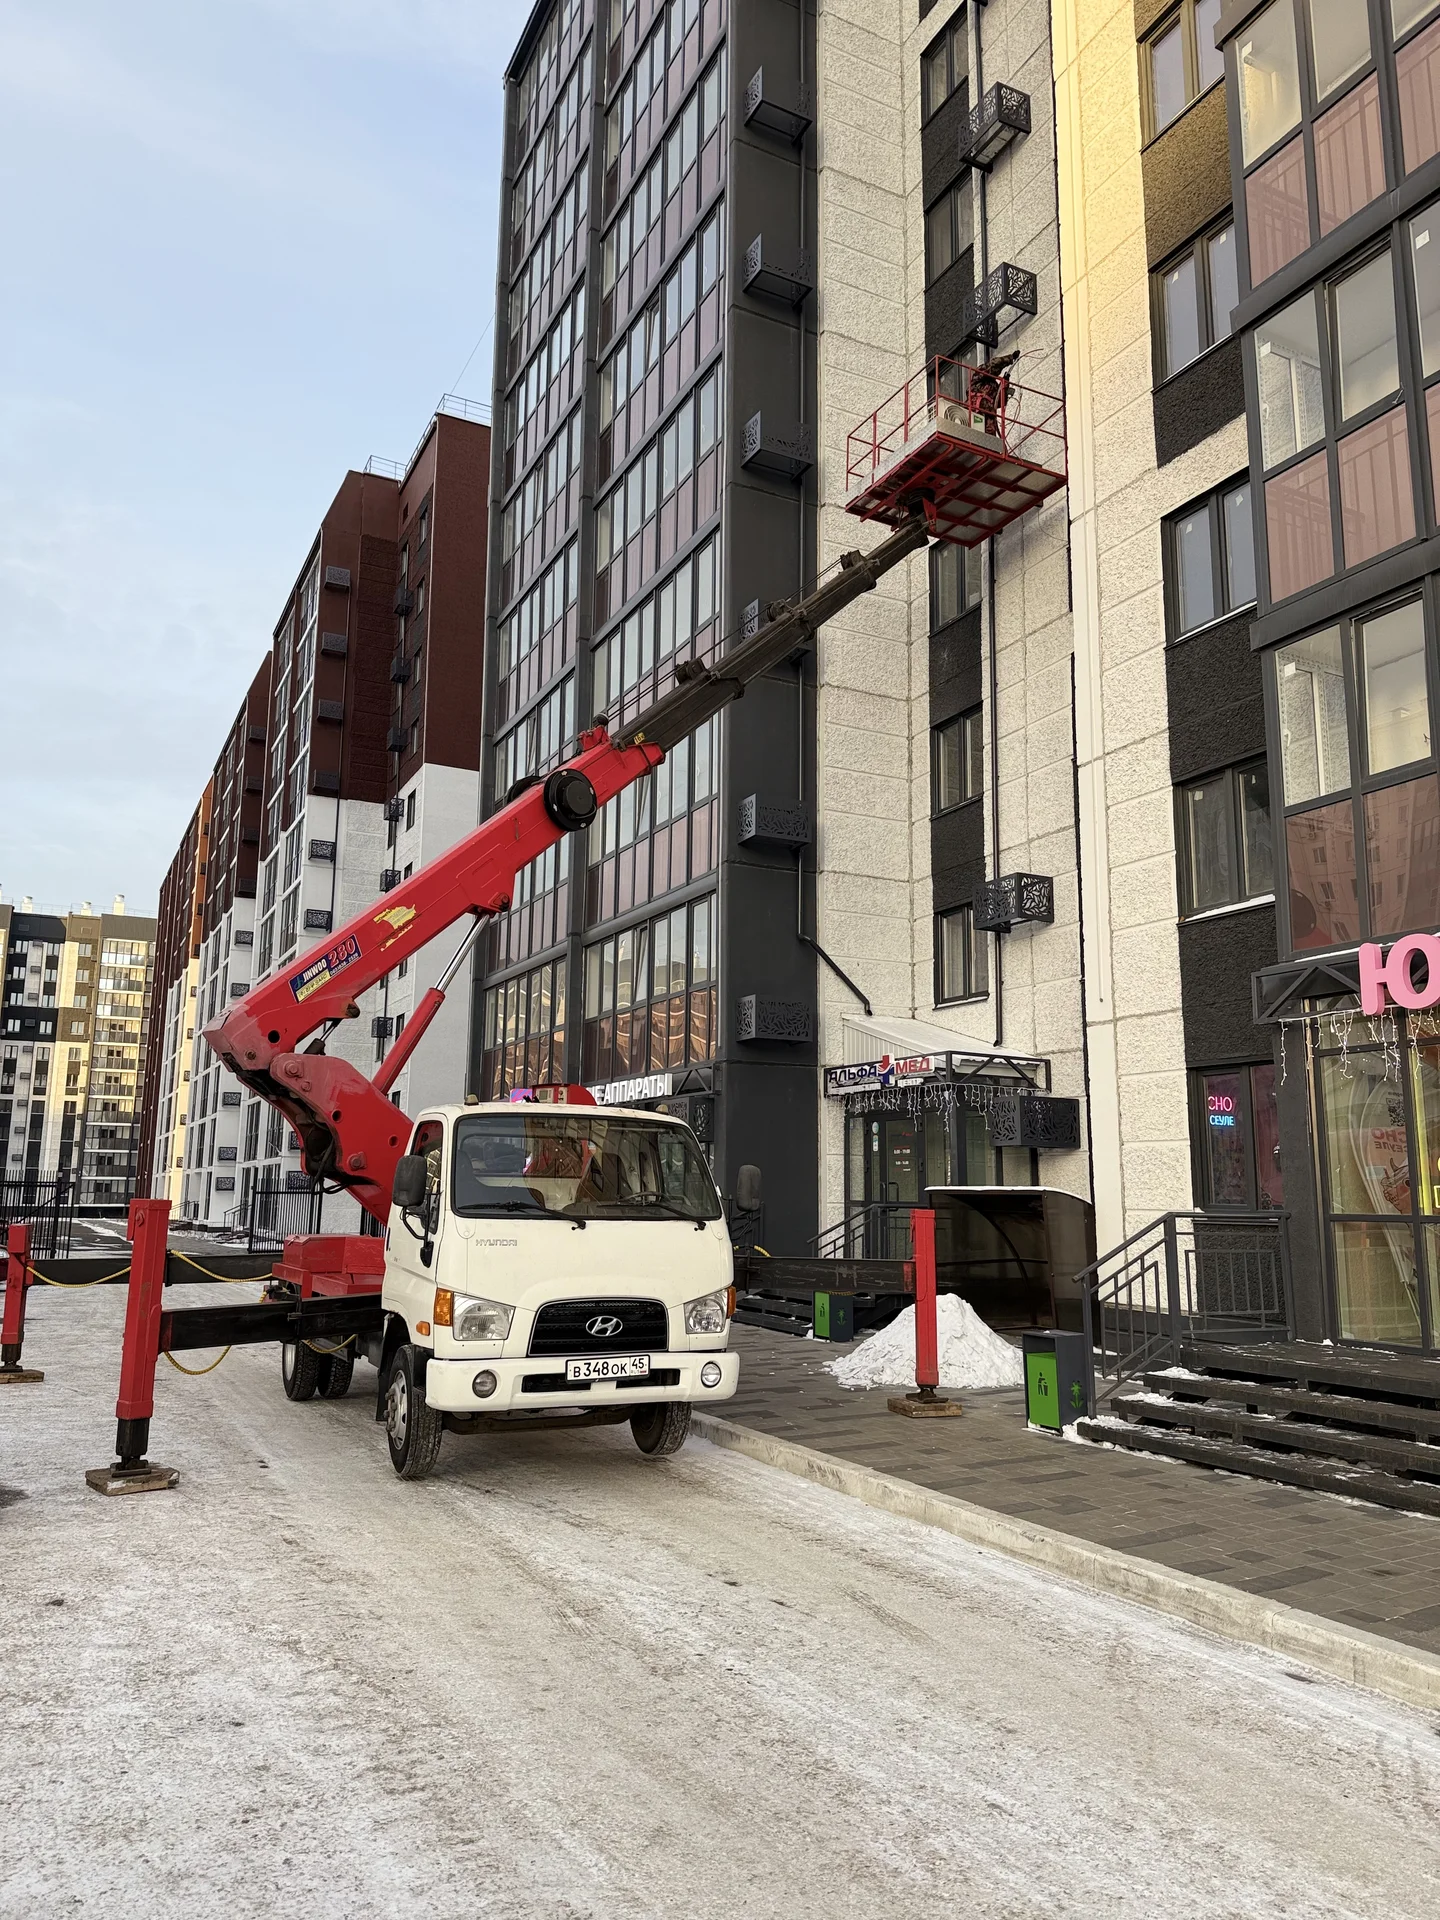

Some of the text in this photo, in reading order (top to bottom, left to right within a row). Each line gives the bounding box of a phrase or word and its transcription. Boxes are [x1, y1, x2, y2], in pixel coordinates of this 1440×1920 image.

[303, 938, 356, 982] JINWOO 280
[829, 1057, 930, 1082] АЛЬФА МЕД
[604, 1073, 673, 1105] АППАРАТЫ
[1210, 1115, 1235, 1126] СЕУЛЕ
[632, 1358, 644, 1369] 45
